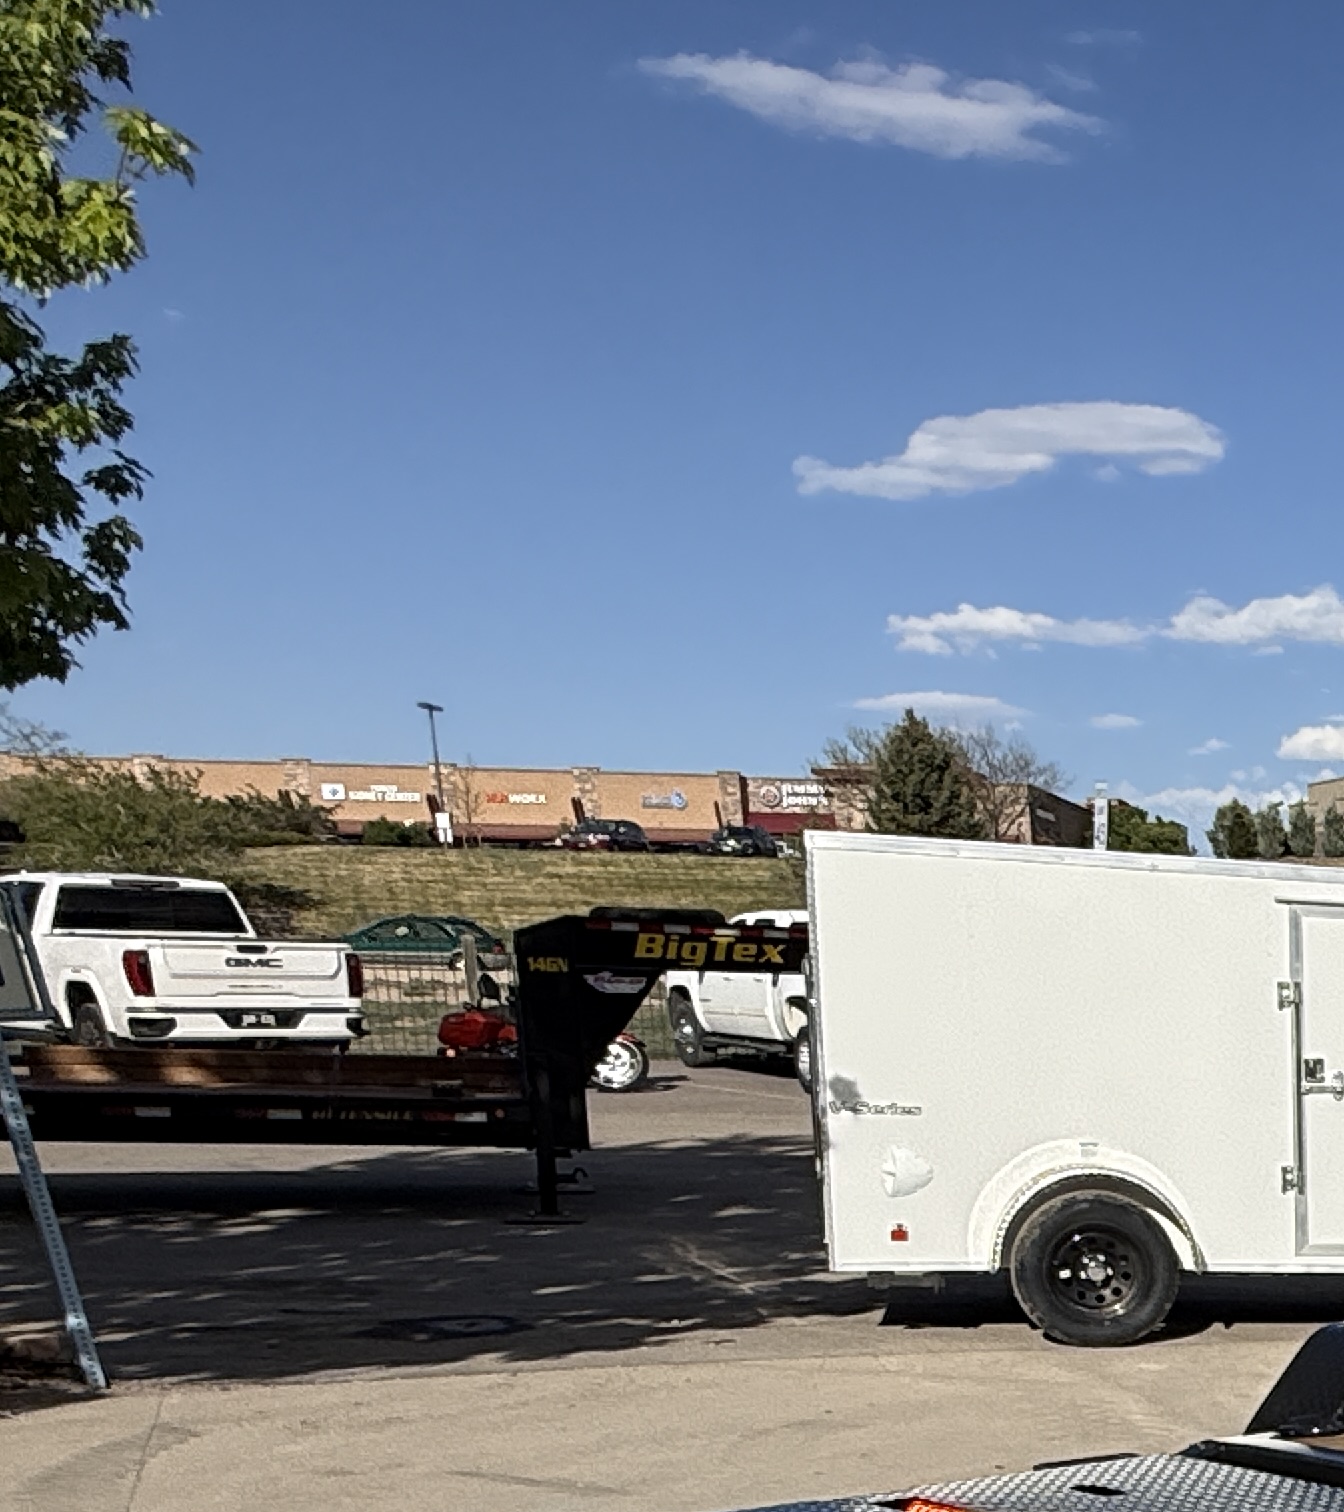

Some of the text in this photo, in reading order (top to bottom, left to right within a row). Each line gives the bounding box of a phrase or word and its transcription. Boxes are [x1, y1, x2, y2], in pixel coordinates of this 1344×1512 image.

[634, 932, 787, 967] BigTex
[225, 957, 283, 968] GMC
[828, 1101, 922, 1116] V-Series
